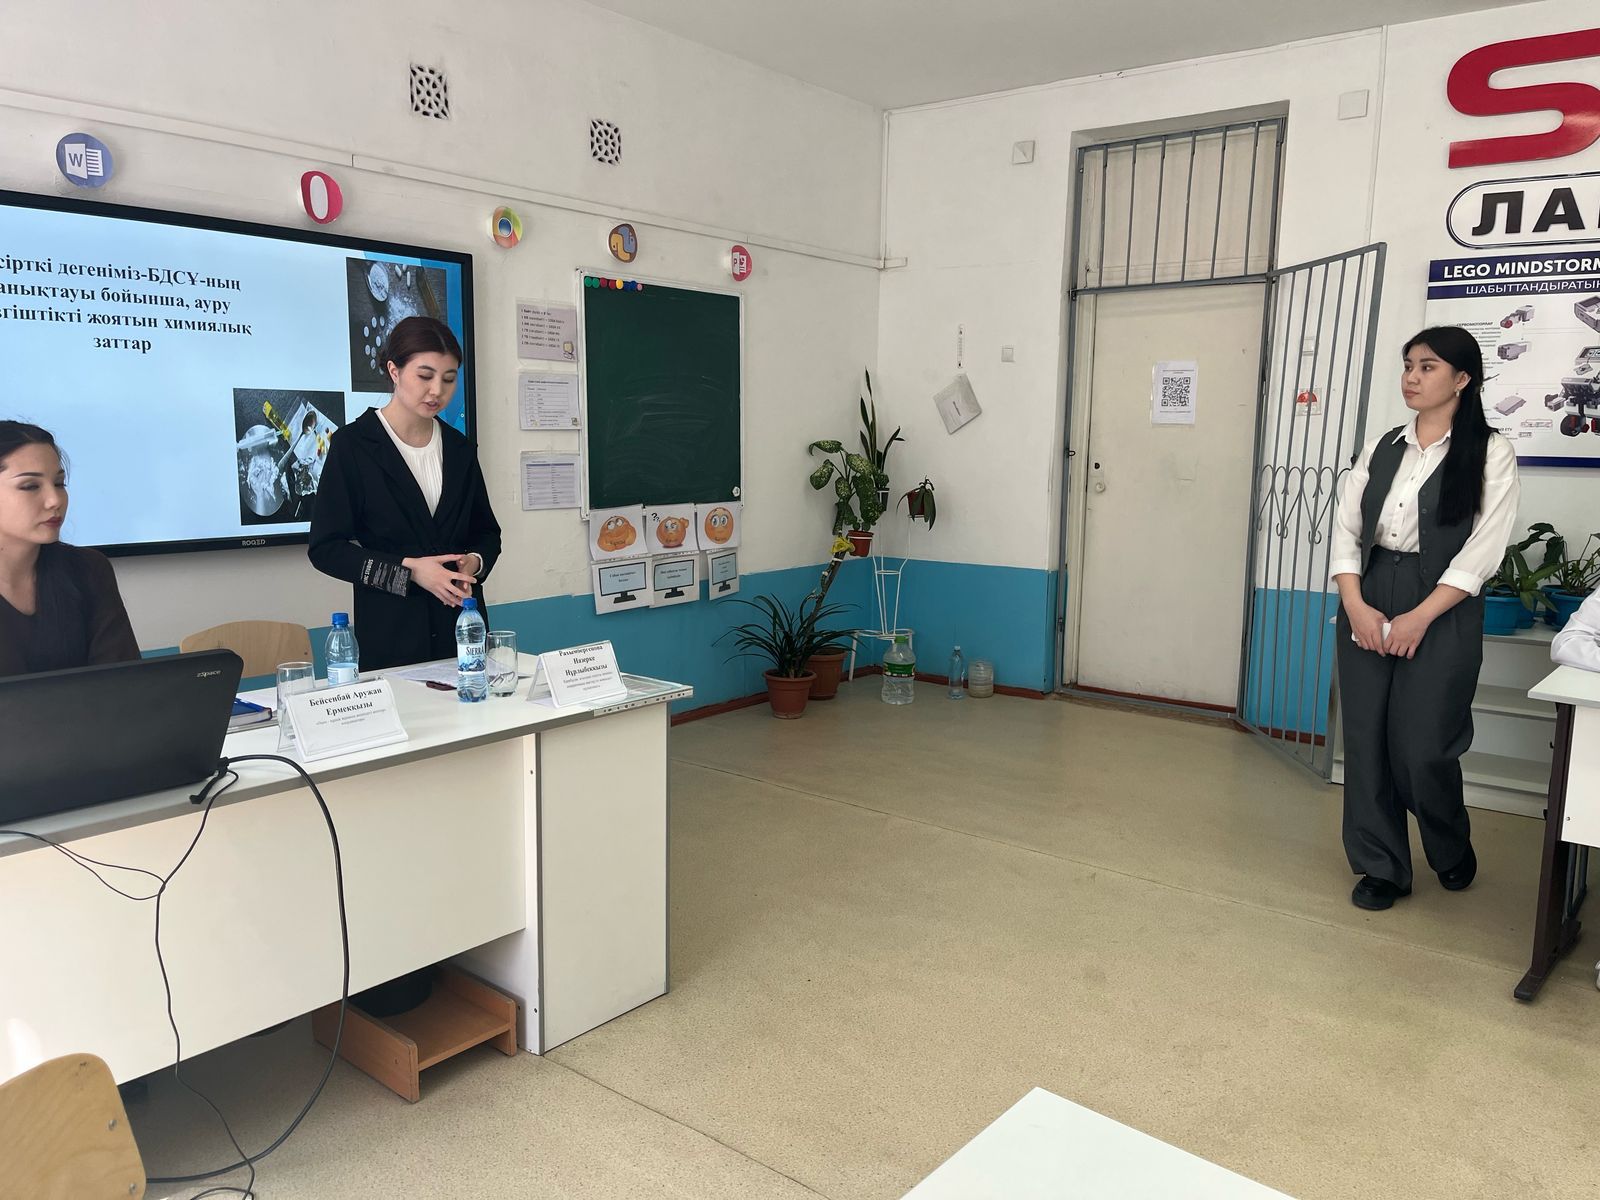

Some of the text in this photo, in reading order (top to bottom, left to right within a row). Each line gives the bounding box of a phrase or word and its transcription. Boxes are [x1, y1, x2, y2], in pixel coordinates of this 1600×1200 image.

[68, 153, 83, 167] W
[1471, 187, 1600, 236] ЛА
[1443, 264, 1491, 279] LEGO
[101, 287, 190, 310] бойынша,
[194, 298, 231, 314] ауру
[87, 311, 158, 328] жоятын
[164, 317, 252, 335] химиялық
[93, 336, 152, 354] заттар
[353, 687, 383, 700] Аружан
